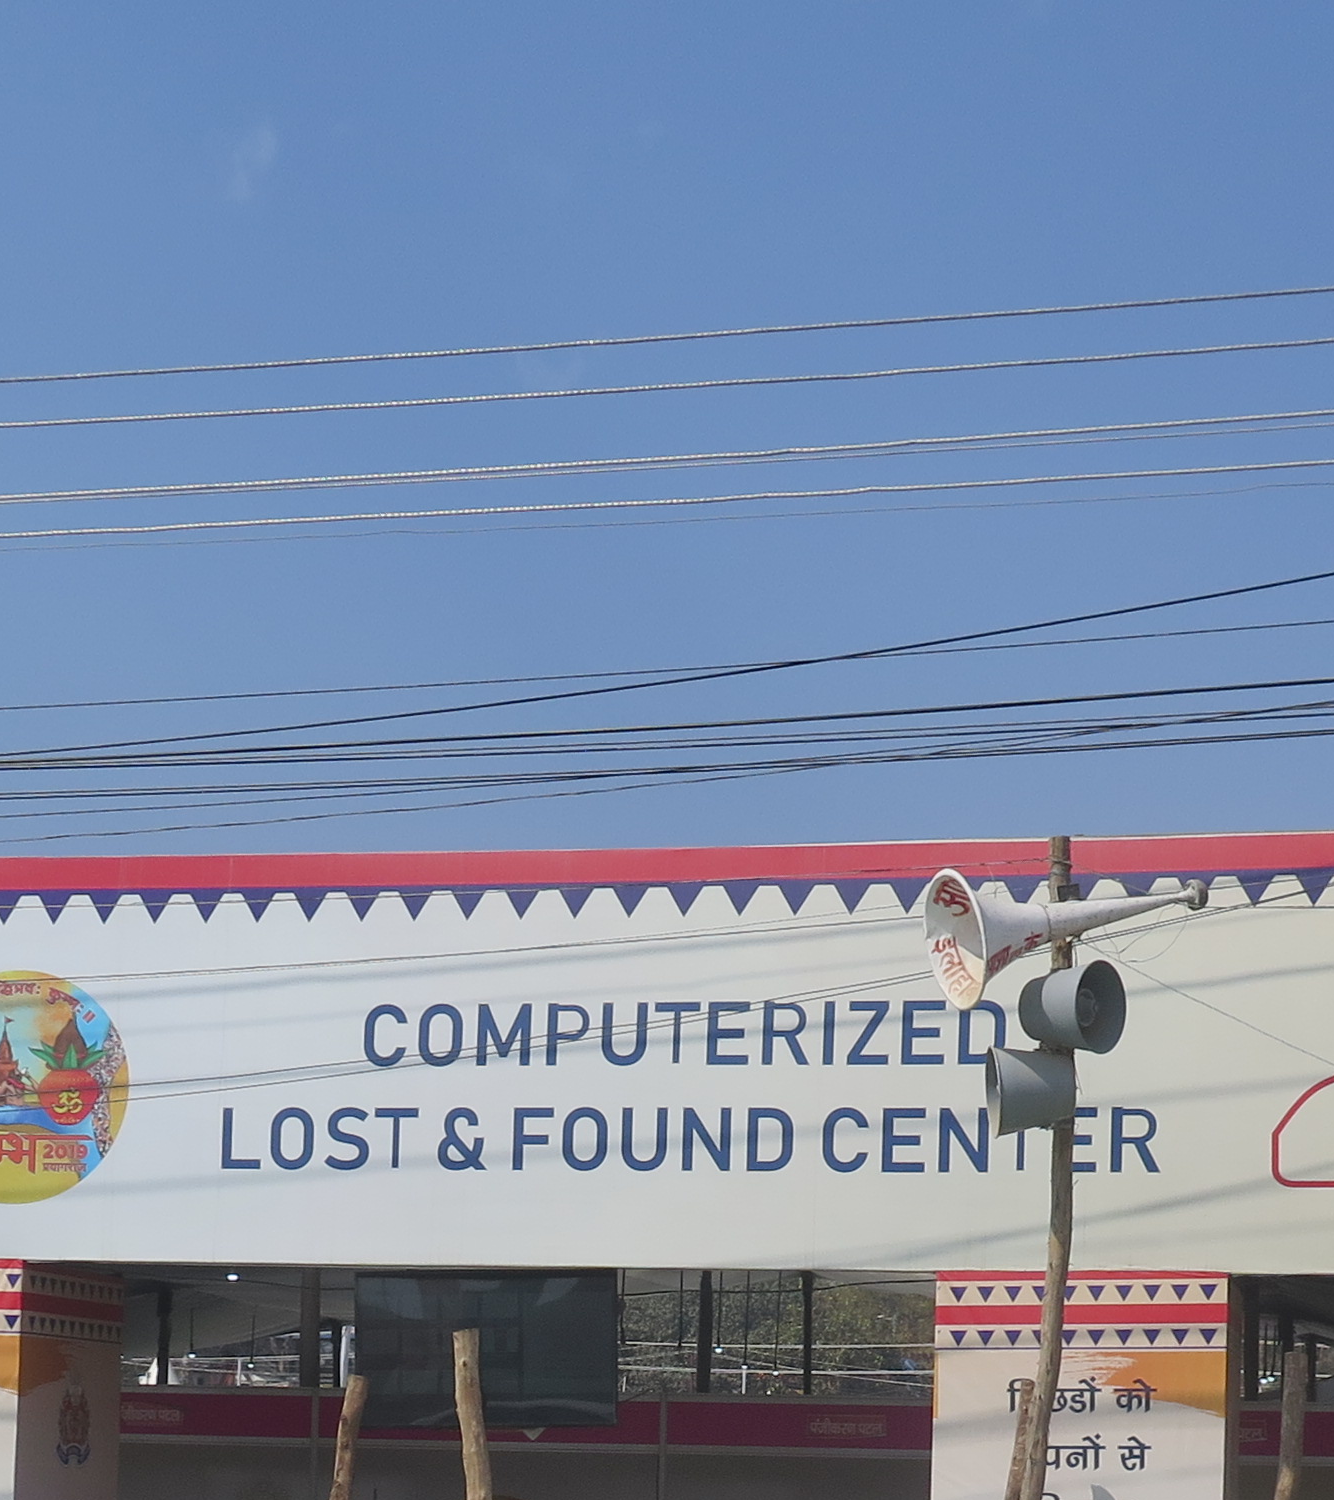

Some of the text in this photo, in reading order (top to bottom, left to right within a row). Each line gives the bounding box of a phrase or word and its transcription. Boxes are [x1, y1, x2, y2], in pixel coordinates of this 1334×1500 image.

[363, 999, 1006, 1067] COMPUTERIZED
[43, 1144, 88, 1160] 2019
[220, 1106, 418, 1172] LOST
[436, 1106, 486, 1172] &
[511, 1106, 795, 1172] FOUND
[1114, 1379, 1157, 1413] को
[1046, 1433, 1151, 1471] पनों से
